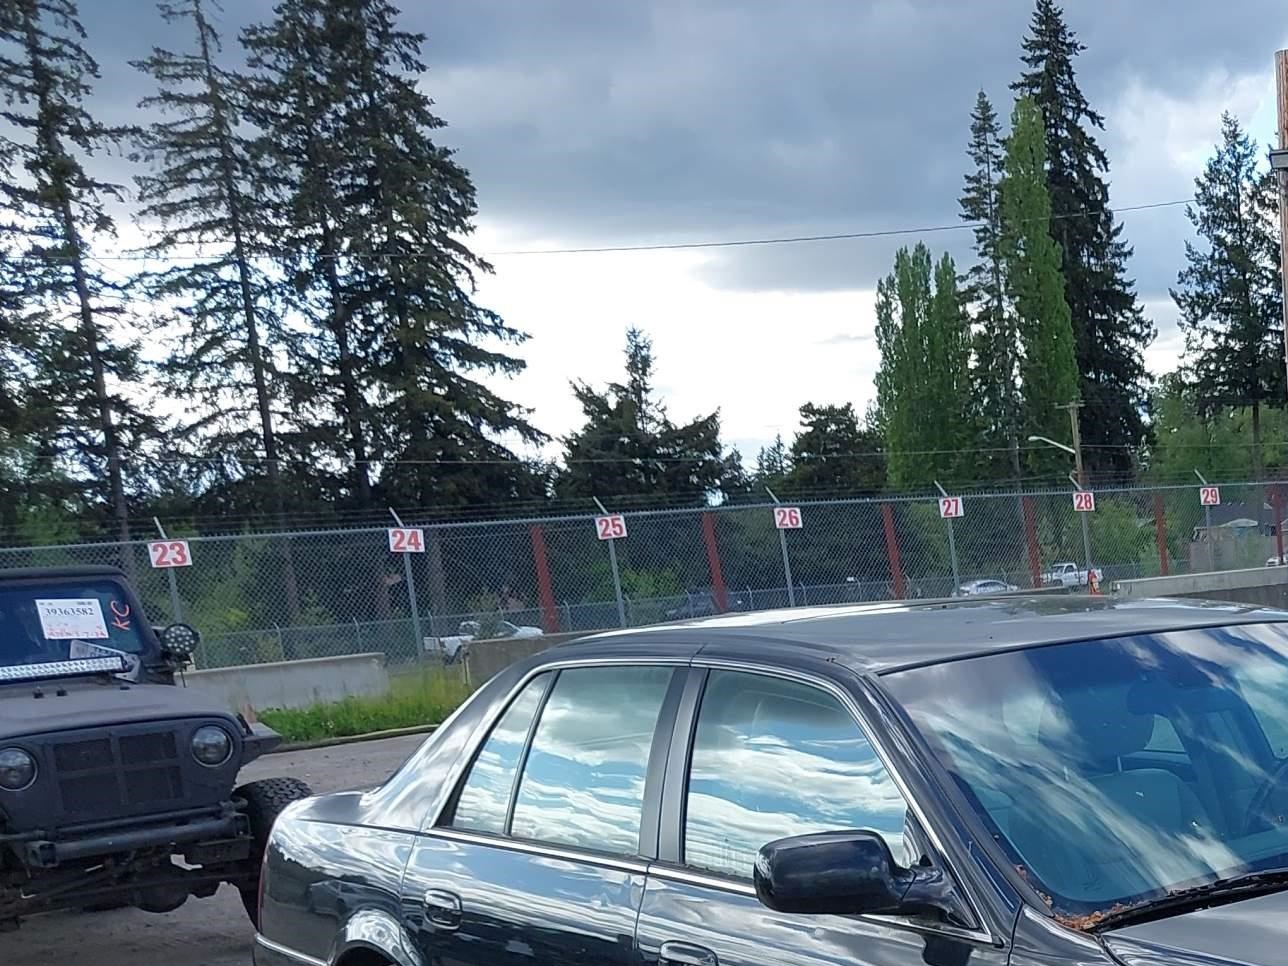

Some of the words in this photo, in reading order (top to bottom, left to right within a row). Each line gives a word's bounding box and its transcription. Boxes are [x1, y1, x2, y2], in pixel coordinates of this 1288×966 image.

[1075, 494, 1092, 510] 28
[1202, 488, 1218, 504] 29
[942, 499, 959, 516] 27
[777, 508, 799, 527] 26
[598, 518, 624, 537] 25
[391, 530, 421, 551] 24
[152, 542, 187, 566] 23
[45, 607, 94, 616] 39363582
[110, 600, 131, 631] KC
